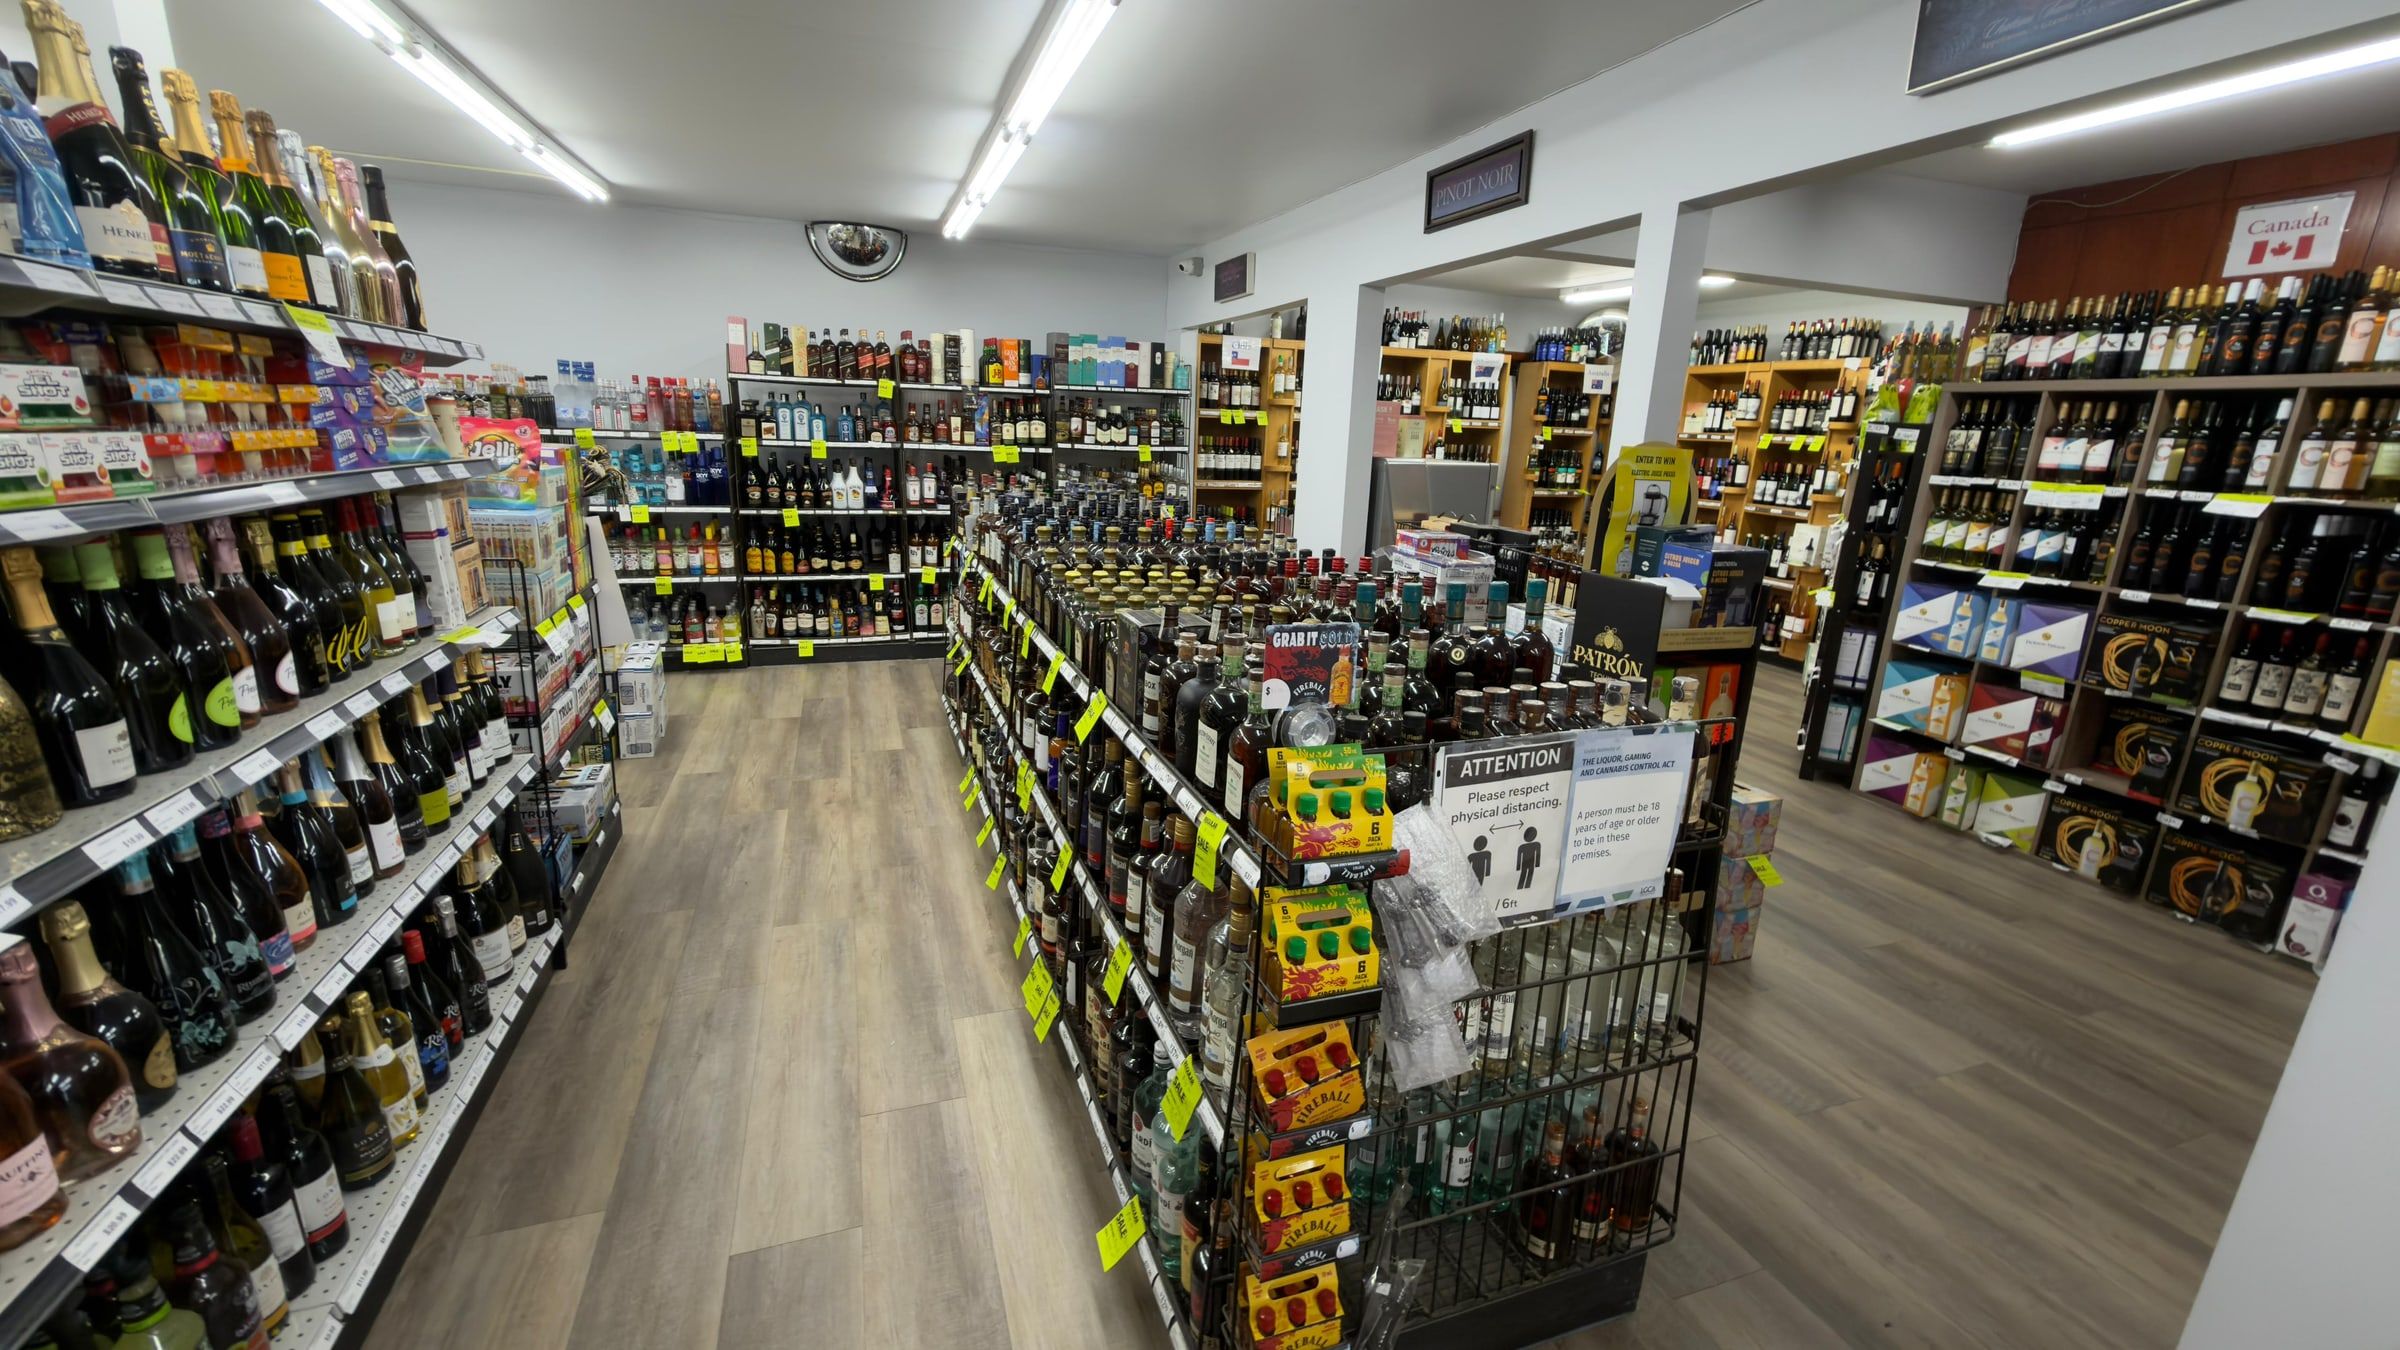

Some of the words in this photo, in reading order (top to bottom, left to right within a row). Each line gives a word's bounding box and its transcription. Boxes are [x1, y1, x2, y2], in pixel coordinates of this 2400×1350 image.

[1436, 177, 1475, 207] PINOT
[1479, 164, 1513, 192] NOIR
[2247, 211, 2330, 236] Canada
[23, 375, 60, 387] JEL
[17, 385, 70, 397] SHOT
[1635, 455, 1654, 464] ENTER
[1655, 456, 1663, 464] TO
[1663, 456, 1676, 465] WIN
[2100, 616, 2137, 629] COPPER
[2139, 624, 2171, 634] MOON
[1272, 631, 1305, 648] GRAB
[1306, 631, 1318, 647] IT
[1573, 644, 1643, 678] PATRÓN
[1265, 686, 1271, 695] $
[1293, 681, 1326, 696] FIREBALL
[1277, 751, 1283, 760] 6
[2197, 738, 2241, 754] COPPER
[2242, 750, 2278, 763] MOON
[1296, 762, 1303, 771] 6
[1460, 748, 1561, 778] ATTENTION
[1582, 758, 1596, 766] THE
[1596, 755, 1624, 765] LIQUOR,
[1624, 752, 1652, 762] GAMING
[1580, 768, 1594, 777] AND
[1595, 765, 1629, 775] CANNABIS
[1630, 762, 1661, 772] CONTROL
[1661, 760, 1676, 769] ACT
[1468, 790, 1505, 803] Please
[1508, 781, 1550, 797] respect
[1451, 806, 1499, 825] physical
[1502, 798, 1562, 815] distancing.
[1577, 811, 1583, 820] A
[1584, 806, 1613, 820] person
[1614, 804, 1635, 815] must
[1637, 802, 1648, 813] be
[1650, 802, 1661, 811] 18
[2054, 797, 2088, 813] COPPER
[2089, 809, 2119, 821] MOON
[1371, 822, 1380, 835] 6
[1575, 824, 1597, 836] years
[1598, 820, 1608, 830] of
[1609, 820, 1624, 831] age
[1625, 818, 1636, 827] or
[1637, 815, 1661, 825] older
[1197, 836, 1209, 852] SALE
[1573, 839, 1582, 848] to
[1583, 836, 1595, 846] be
[1596, 834, 1605, 844] in
[1606, 832, 1631, 843] these
[1571, 851, 1612, 863] premises.
[1341, 864, 1375, 881] FIREBALL
[1264, 890, 1271, 899] 6
[1640, 885, 1657, 895] LGCA
[1281, 905, 1289, 915] 6
[1502, 898, 1518, 909] 6ft
[1358, 961, 1366, 973] 6
[1173, 1076, 1186, 1103] SALE
[1295, 1090, 1351, 1124] FIREBALL
[1305, 1129, 1340, 1146] FIREBALL
